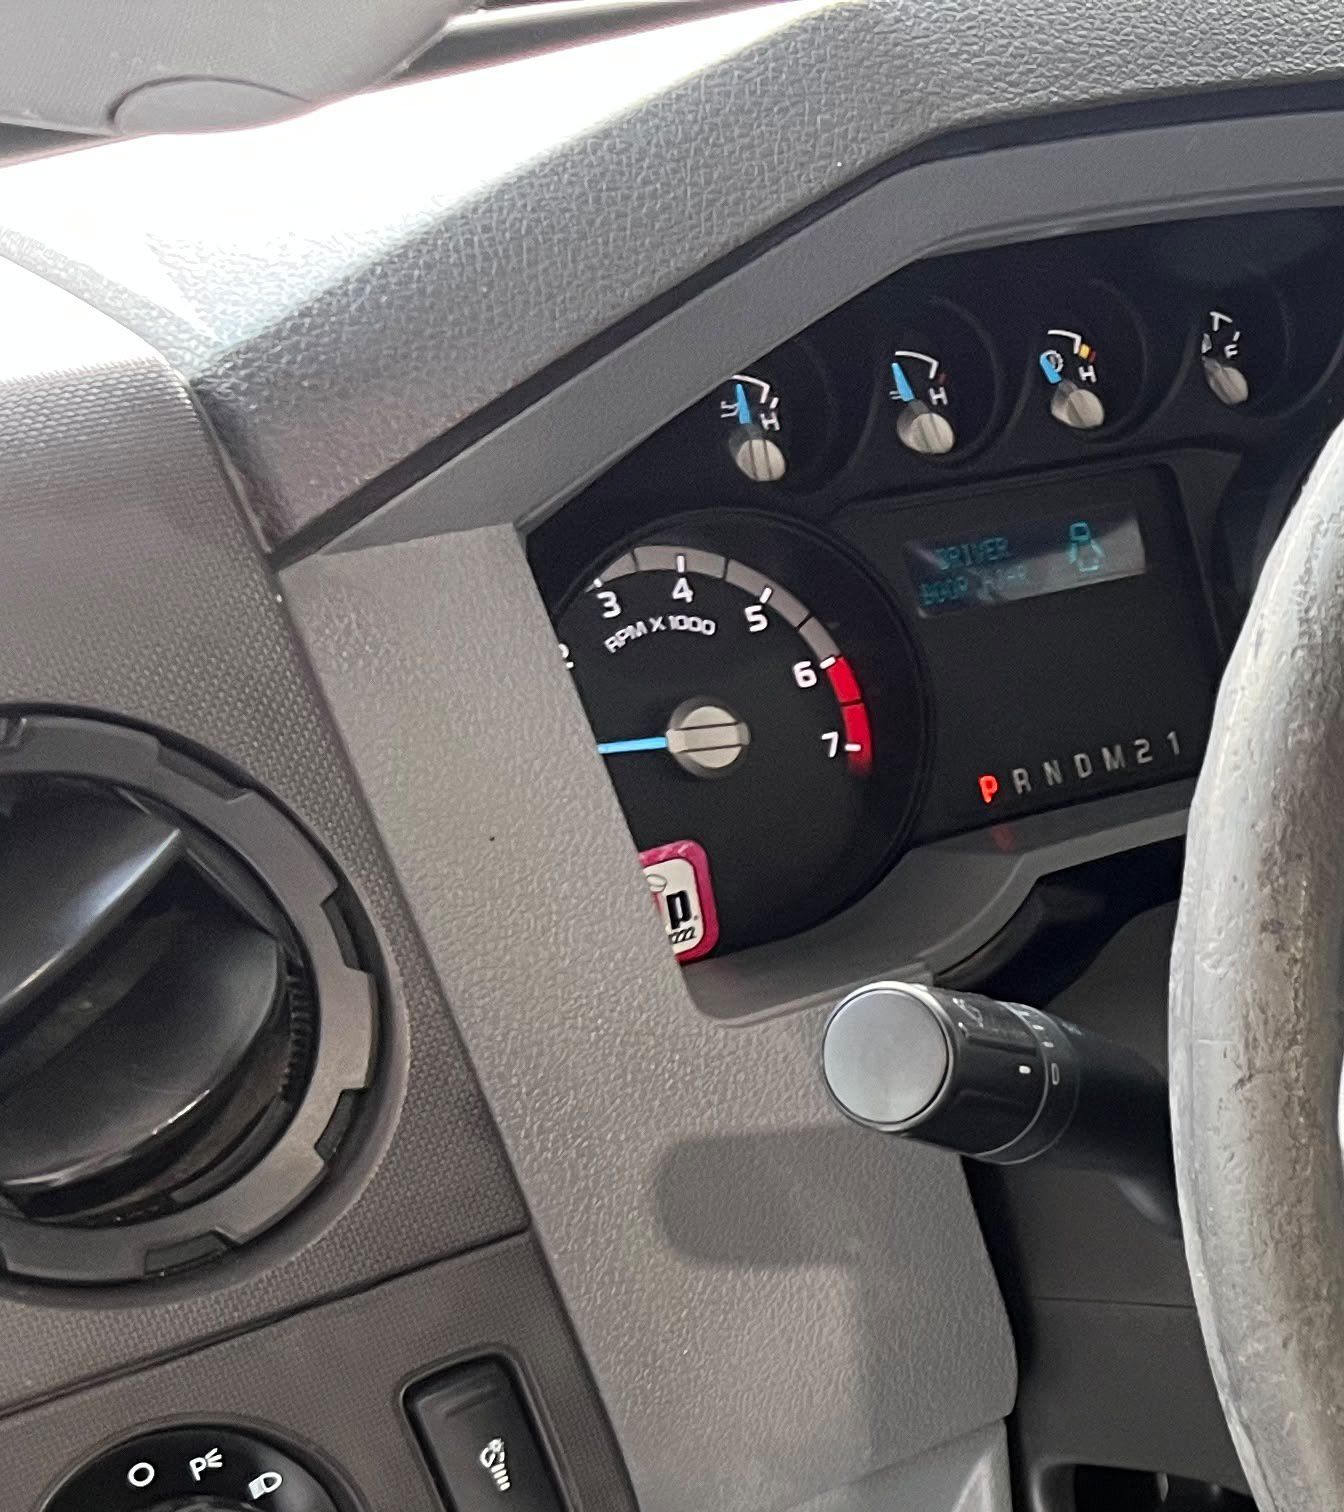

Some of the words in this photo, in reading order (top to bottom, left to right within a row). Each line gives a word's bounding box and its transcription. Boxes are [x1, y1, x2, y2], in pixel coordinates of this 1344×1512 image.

[1078, 365, 1097, 383] H
[928, 386, 948, 406] H
[760, 412, 780, 431] H
[596, 590, 622, 618] 3
[672, 577, 694, 604] 4
[744, 604, 769, 633] 5
[604, 621, 648, 654] RPM
[669, 614, 717, 636] 1000
[792, 660, 817, 688] 6
[821, 731, 839, 758] 7
[978, 775, 998, 804] P
[1012, 767, 1032, 795] R
[1043, 759, 1063, 786] N
[1074, 753, 1093, 779] D
[1101, 744, 1126, 772] M
[1134, 738, 1153, 764] 2
[1167, 730, 1180, 756] 1
